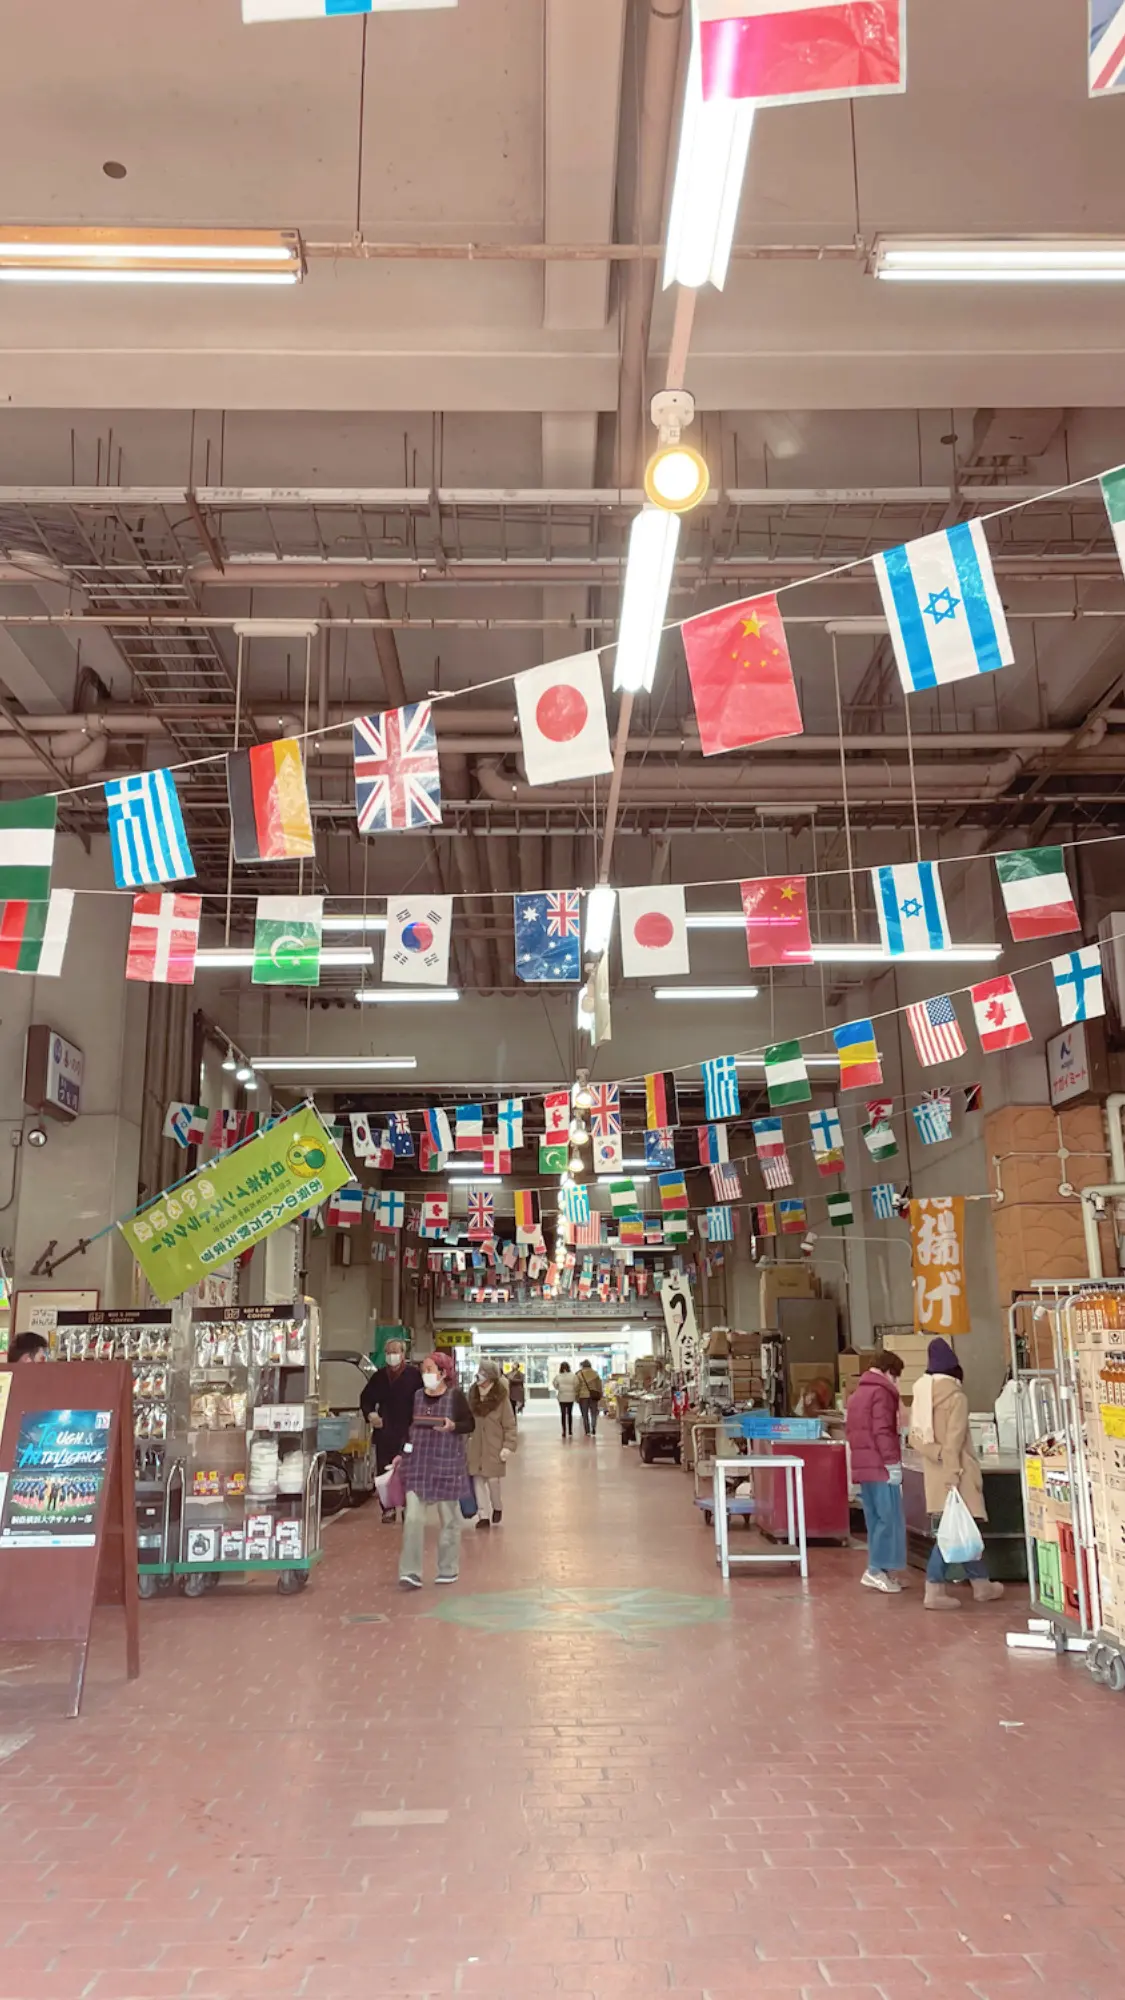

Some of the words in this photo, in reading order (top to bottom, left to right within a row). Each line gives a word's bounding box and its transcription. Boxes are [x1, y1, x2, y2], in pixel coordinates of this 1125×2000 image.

[151, 1161, 286, 1253] 日本茶インストラクター
[201, 1179, 323, 1263] お茶の入れ方教えます
